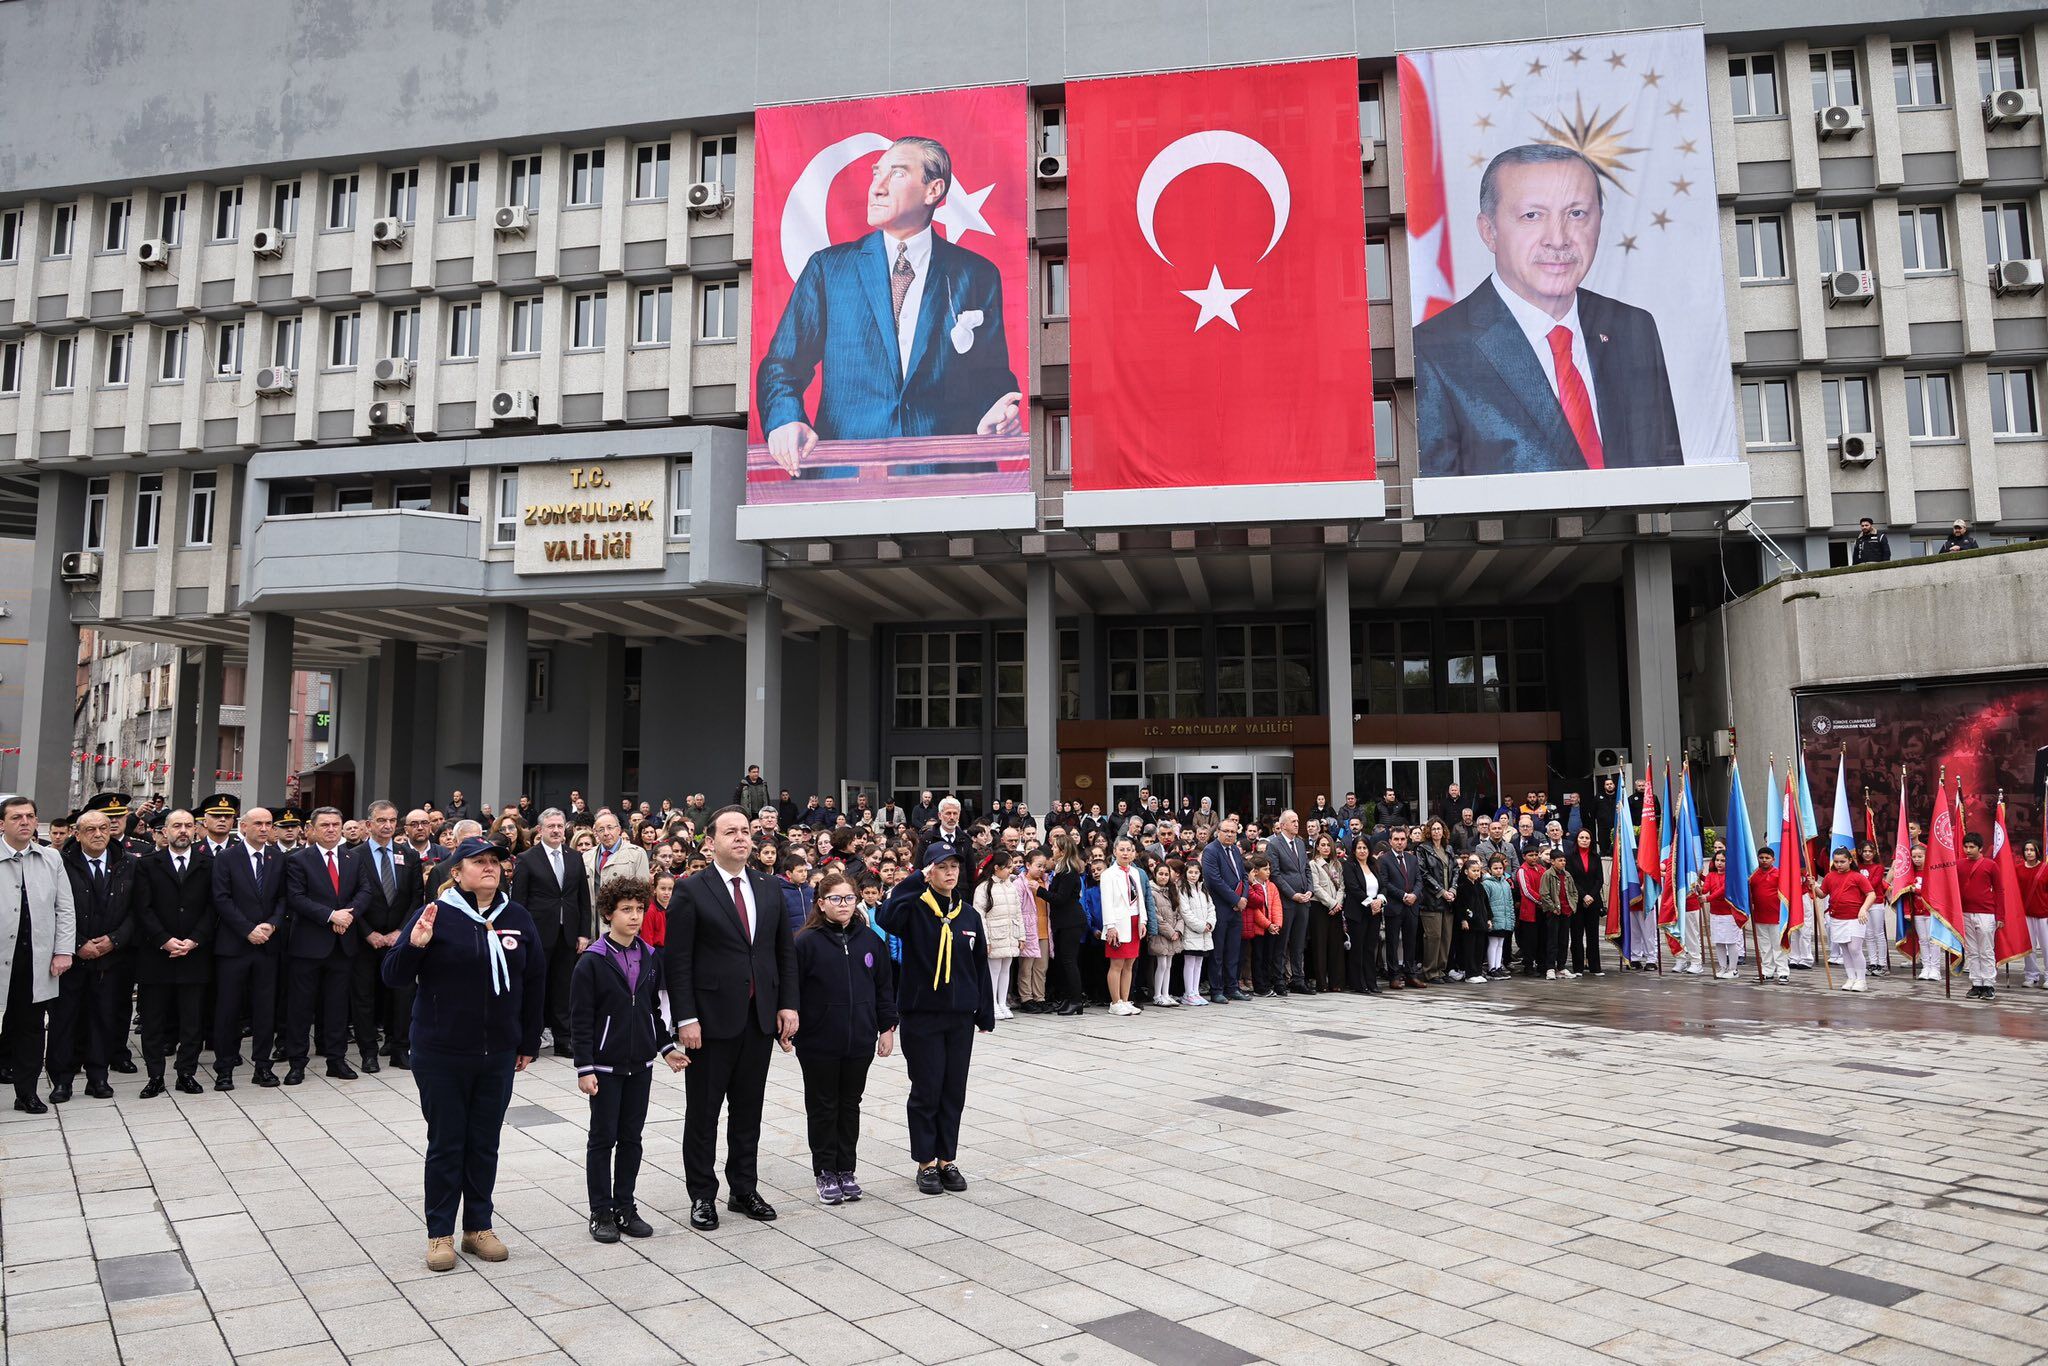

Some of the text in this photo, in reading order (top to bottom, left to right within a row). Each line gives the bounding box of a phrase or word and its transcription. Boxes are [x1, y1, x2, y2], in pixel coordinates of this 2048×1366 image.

[570, 467, 610, 489] T.C.
[524, 499, 654, 526] ZONGULDAK
[544, 532, 632, 562] VALİLİĞİ
[1144, 720, 1293, 736] T.C. ZONGULDAK VALİLİĞİ
